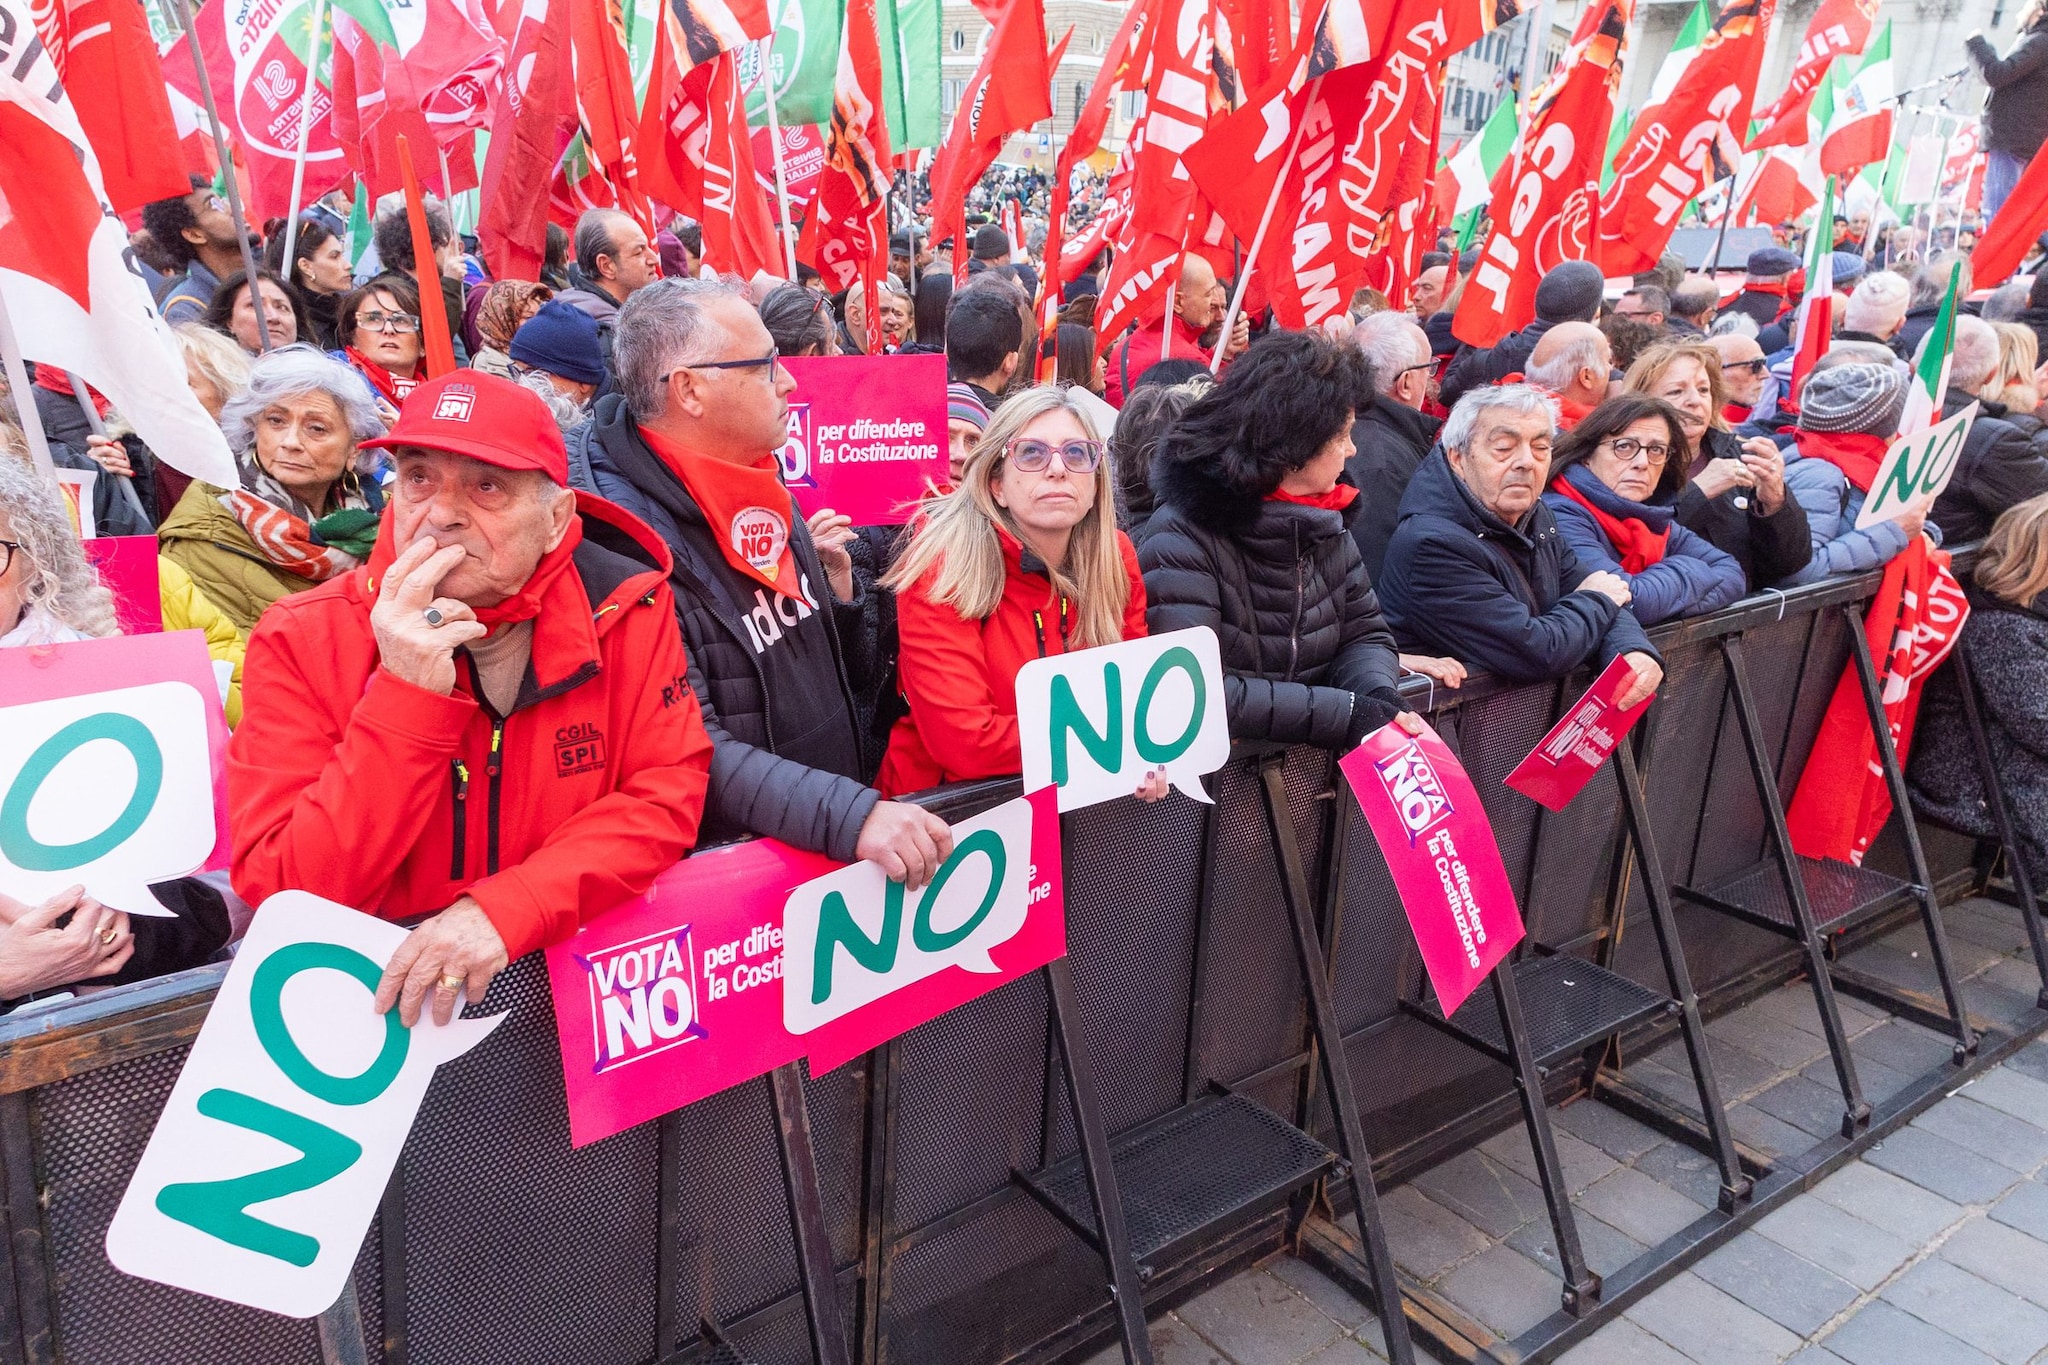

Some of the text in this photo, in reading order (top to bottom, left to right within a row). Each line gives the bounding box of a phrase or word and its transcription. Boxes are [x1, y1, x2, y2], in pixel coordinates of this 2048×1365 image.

[437, 400, 469, 419] SPI
[817, 417, 926, 446] per difendere
[819, 440, 938, 464] la Costituzione
[1871, 417, 1966, 514] NO
[740, 522, 775, 537] VOTA
[741, 536, 773, 560] NO
[555, 721, 599, 742] CGIL
[1050, 646, 1206, 787] NO
[1545, 720, 1585, 760] NO
[561, 743, 597, 766] SPI
[1405, 745, 1446, 814] VOTA
[1382, 756, 1432, 831] NO
[1426, 837, 1481, 969] la Costituzione
[1435, 828, 1487, 945] per difendere
[811, 829, 1007, 1004] NO
[592, 939, 684, 997] VOTA
[703, 922, 784, 978] per dife
[708, 973, 728, 1002] la
[602, 976, 693, 1060] NO
[155, 942, 411, 1268] NO
